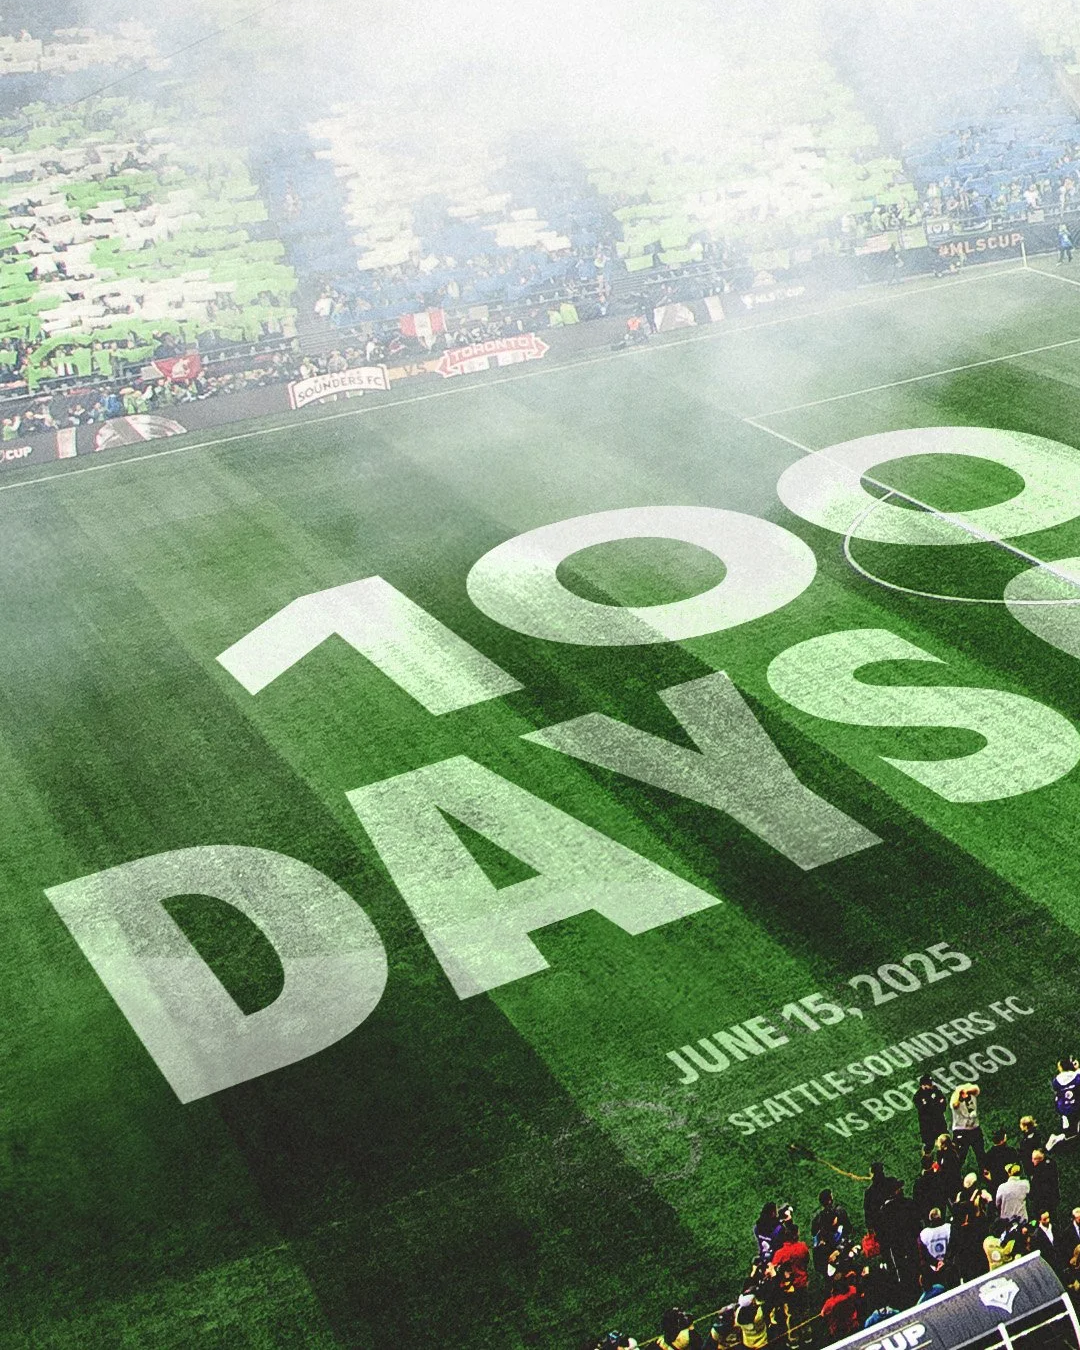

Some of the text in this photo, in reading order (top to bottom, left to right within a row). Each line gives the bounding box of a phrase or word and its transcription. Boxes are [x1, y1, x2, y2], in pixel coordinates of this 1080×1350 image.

[453, 336, 530, 360] TORONTO
[402, 362, 428, 375] VS
[298, 376, 365, 403] SOUNDERS
[366, 376, 384, 388] FC
[6, 446, 32, 461] CUP
